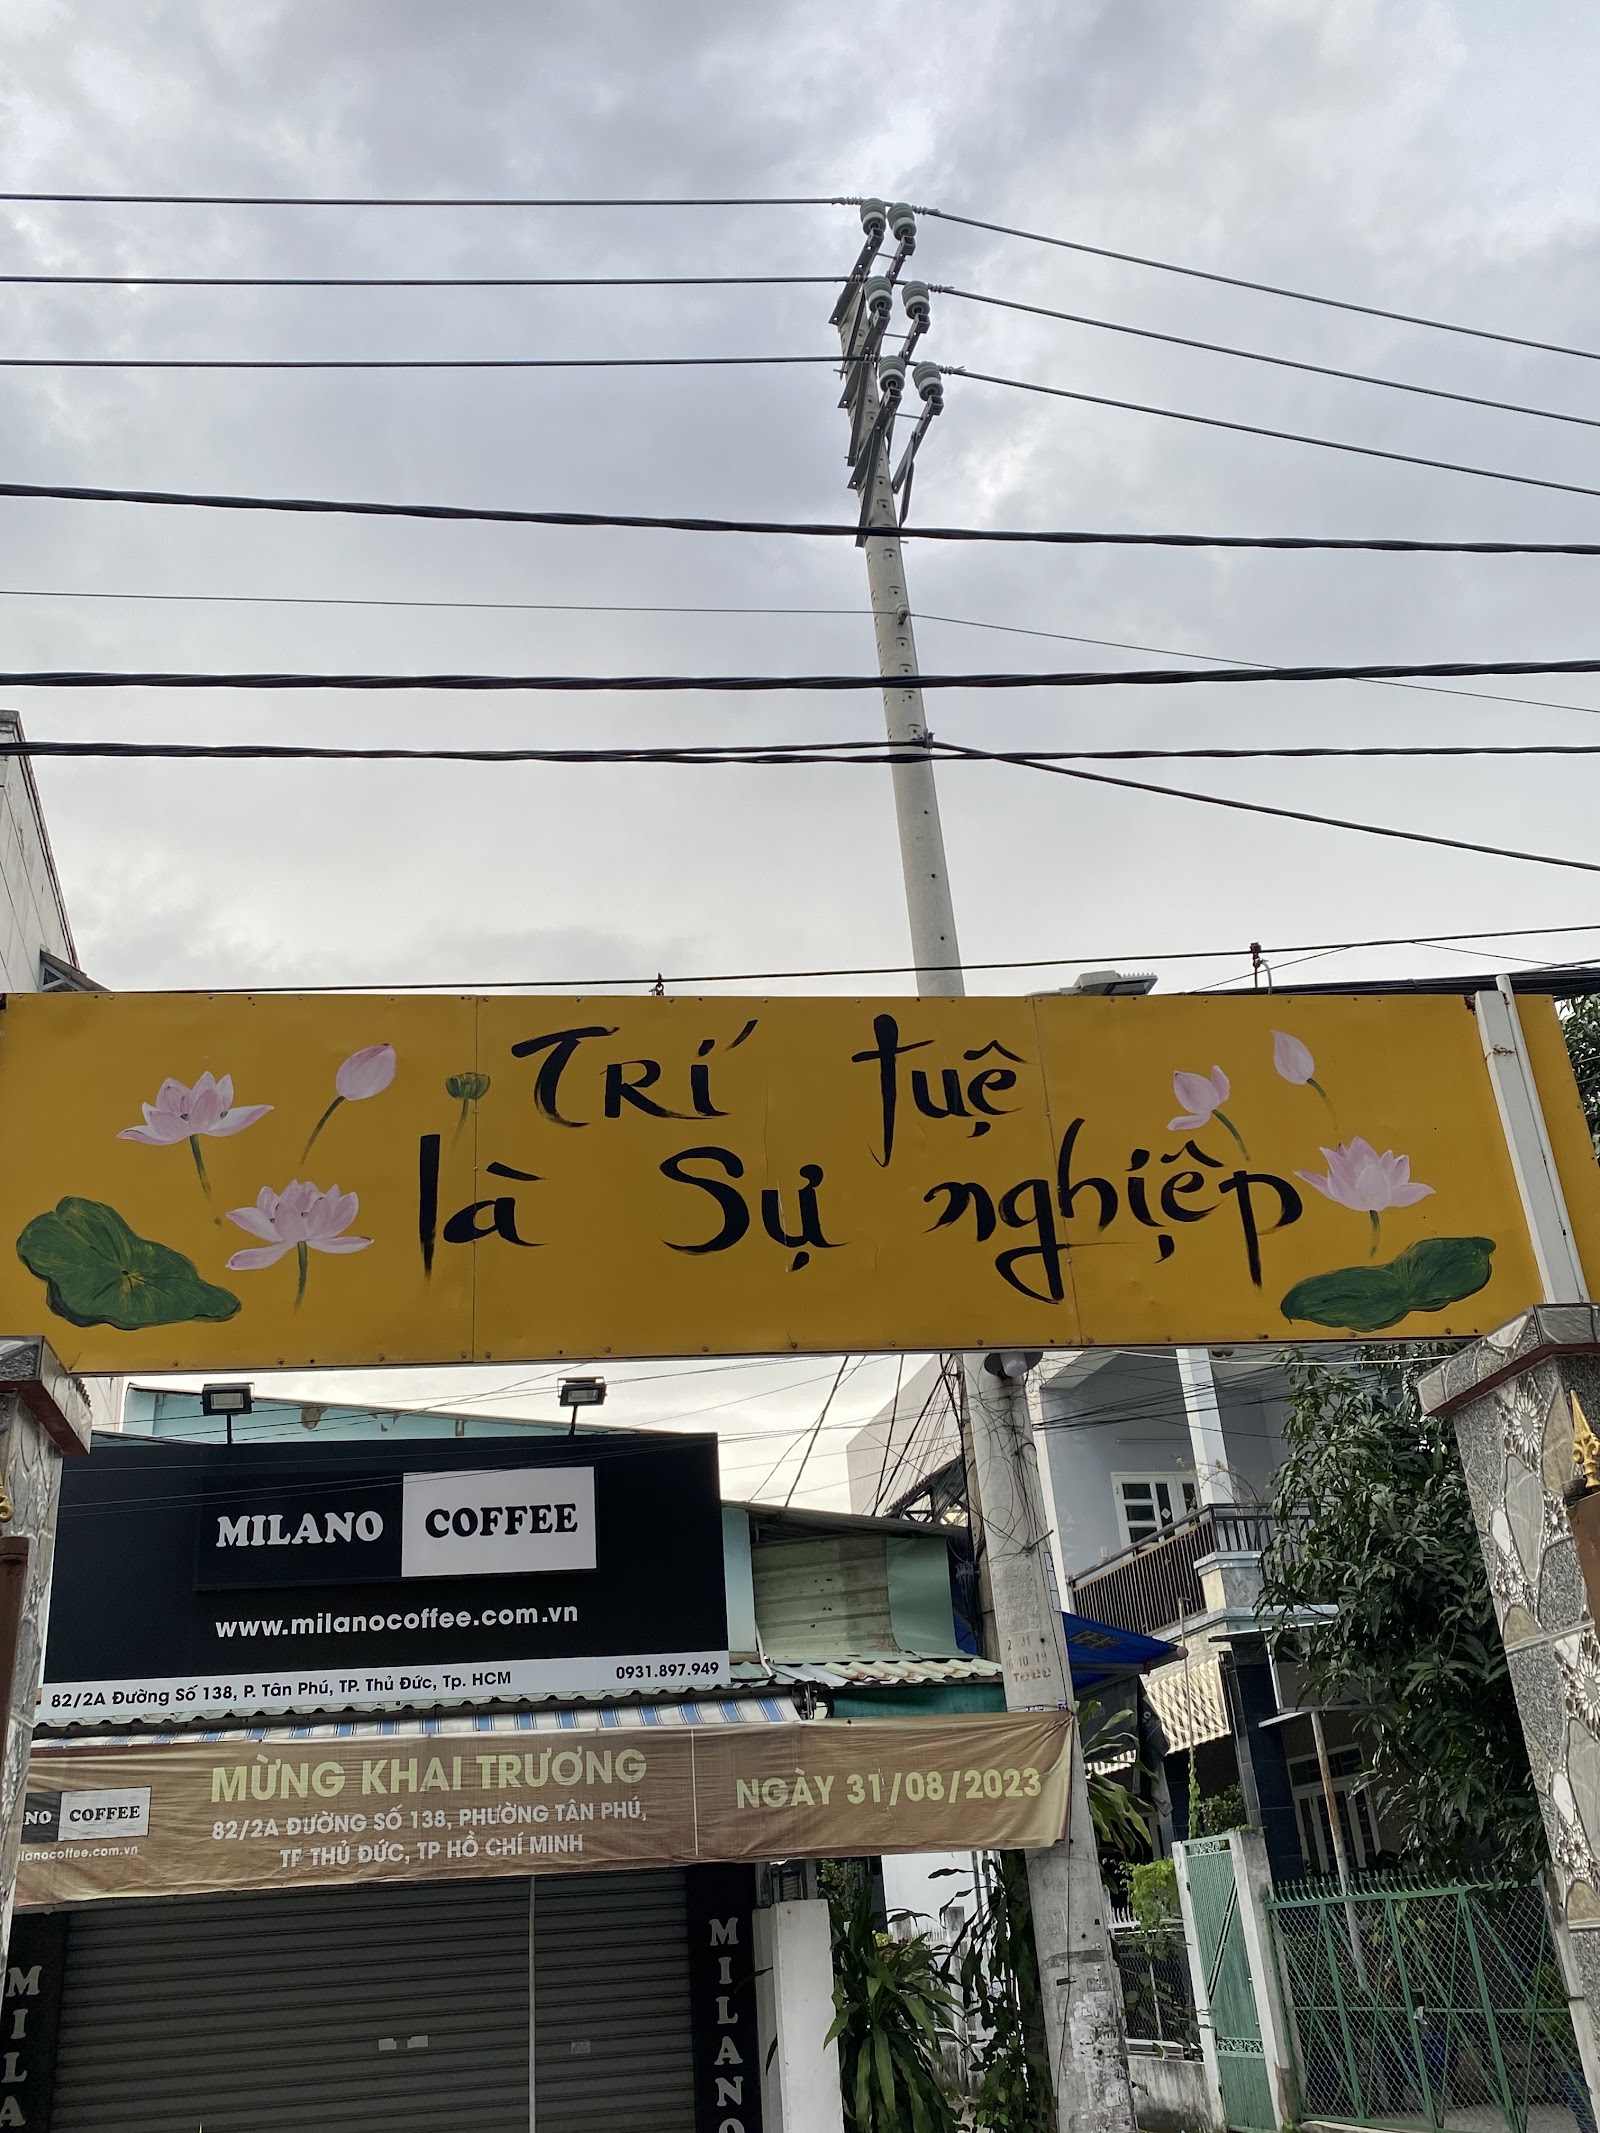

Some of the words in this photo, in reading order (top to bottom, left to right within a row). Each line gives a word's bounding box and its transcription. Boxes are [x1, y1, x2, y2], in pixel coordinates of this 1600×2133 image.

[417, 1134, 547, 1280] là
[659, 1146, 851, 1272] Sự
[924, 1117, 1303, 1305] nghiệp
[216, 1511, 384, 1547] MILANO
[425, 1503, 578, 1538] COFFEE
[215, 1605, 578, 1638] www.milanocoffee.com.vn
[51, 1692, 106, 1709] 82/2A
[112, 1688, 169, 1706] Đường
[175, 1684, 197, 1702] Số
[203, 1686, 237, 1702] 138,
[244, 1684, 257, 1698] P.
[262, 1682, 292, 1698] Tân
[298, 1680, 333, 1697] Phú,
[339, 1679, 360, 1693] TP.
[365, 1675, 394, 1692] Thủ
[400, 1672, 437, 1691] Đức,
[442, 1673, 467, 1691] Tp.
[472, 1671, 511, 1686] HCM
[615, 1661, 719, 1680] 0931.897.949
[211, 1753, 346, 1803] MỪNG
[361, 1756, 462, 1795] KHAI
[476, 1746, 647, 1791] TRƯƠNG
[736, 1766, 835, 1809] NGÀY
[846, 1767, 1042, 1807] 31/08/2023
[21, 1810, 52, 1826] NO
[69, 1806, 140, 1822] COFFEE
[211, 1818, 279, 1841] 82/2A
[286, 1809, 367, 1836] ĐƯỜNG
[373, 1803, 403, 1832] SỐ
[410, 1809, 452, 1830] 138,
[459, 1801, 549, 1827] PHƯỜNG
[555, 1798, 594, 1822] TÂN
[601, 1795, 647, 1822] PHÚ,
[310, 1840, 350, 1867] THỦ
[357, 1838, 410, 1864] ĐỨC,
[417, 1841, 441, 1860] TP
[447, 1830, 479, 1859] HỒ
[485, 1831, 524, 1856] CHÍ
[529, 1833, 583, 1855] MINH
